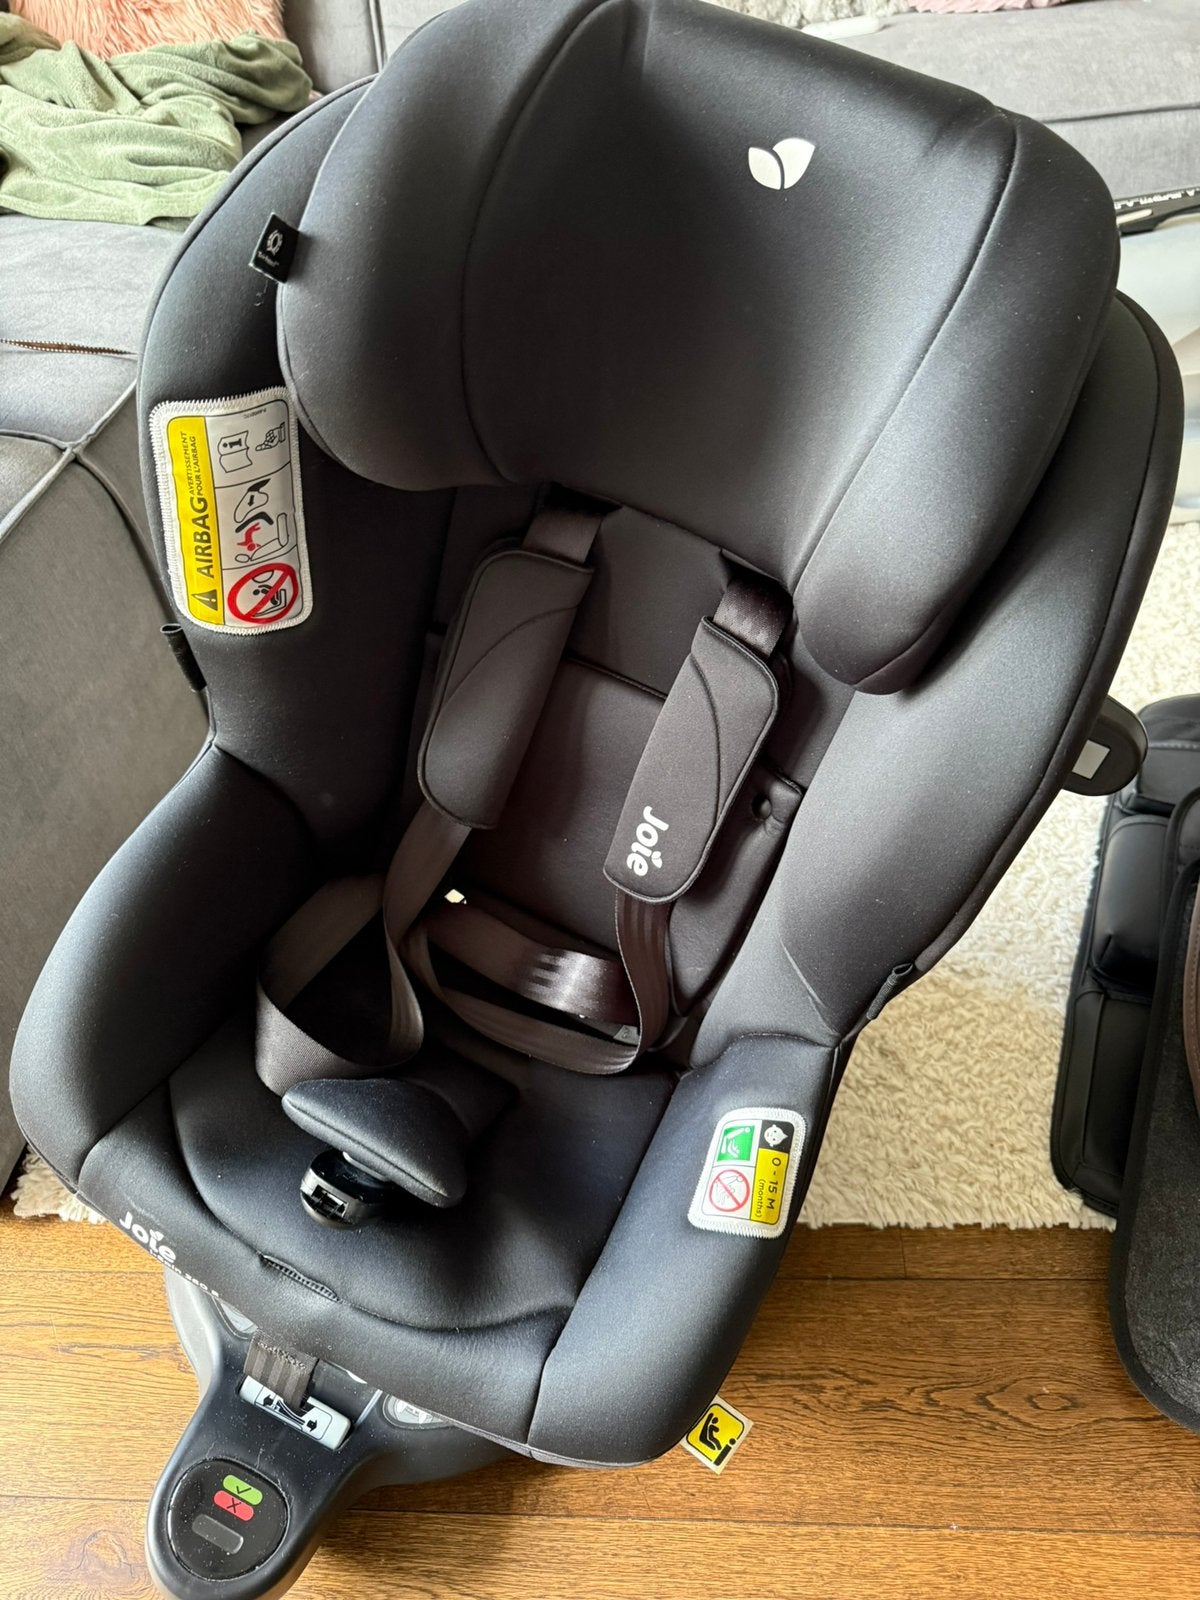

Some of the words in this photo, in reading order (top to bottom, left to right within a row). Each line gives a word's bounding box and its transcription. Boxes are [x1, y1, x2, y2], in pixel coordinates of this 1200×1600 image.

[180, 431, 195, 495] AVERTISSEMENT
[189, 436, 200, 473] L'AIRBAG
[194, 472, 203, 496] POUR
[189, 496, 215, 579] AIRBAG
[626, 805, 670, 877] Joie
[754, 1178, 767, 1218] (months)
[766, 1197, 776, 1210] M
[768, 1180, 779, 1195] 15
[119, 1211, 177, 1264] Joie
